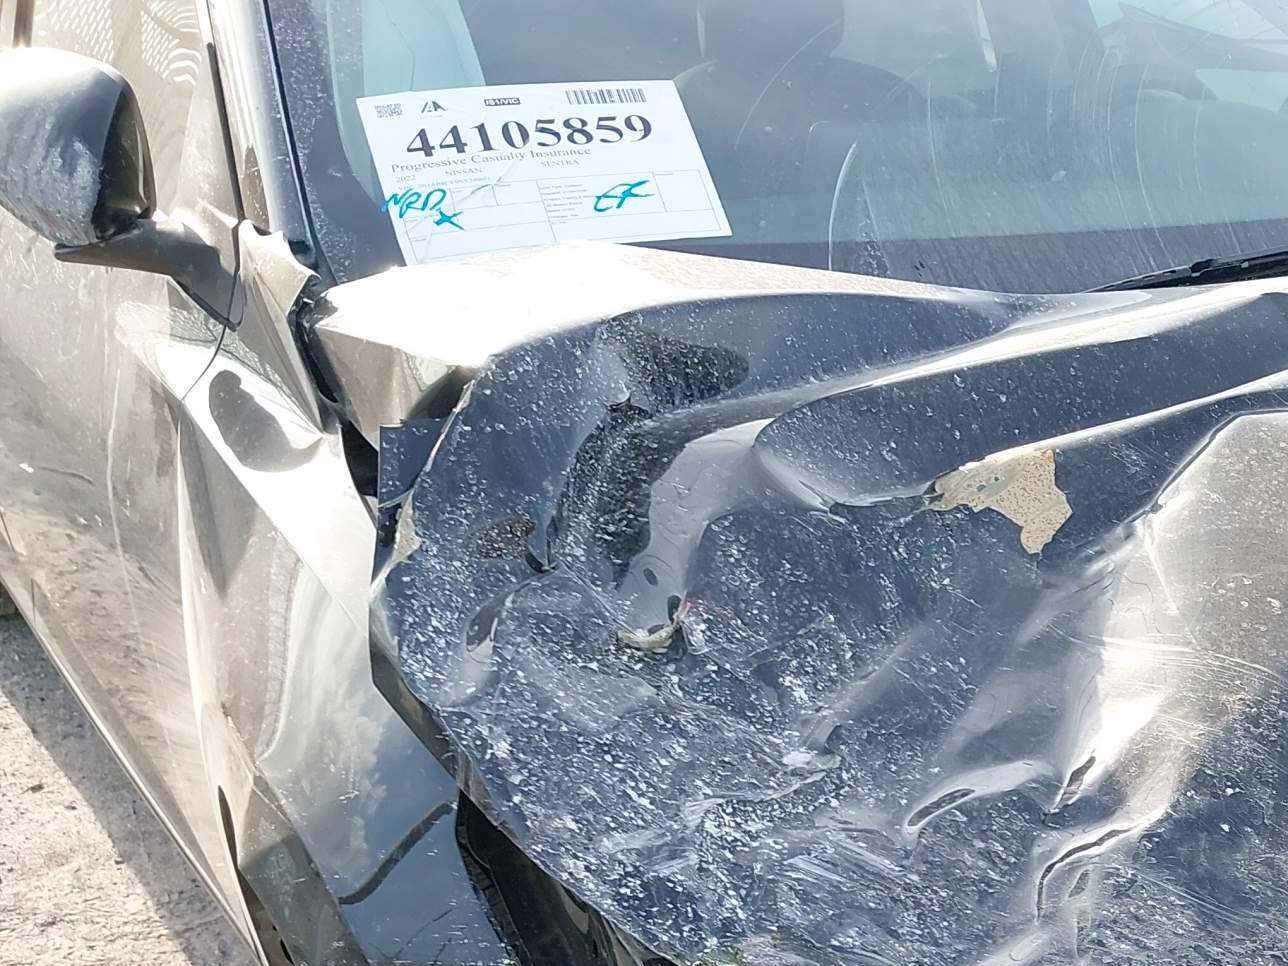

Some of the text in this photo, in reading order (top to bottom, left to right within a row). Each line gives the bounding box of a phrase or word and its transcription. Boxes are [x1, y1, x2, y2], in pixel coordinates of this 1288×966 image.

[406, 114, 652, 157] 44105859
[391, 148, 592, 174] Progressive Casualty Insurance
[444, 167, 482, 177] NISSAN
[539, 158, 580, 168] SENTRA
